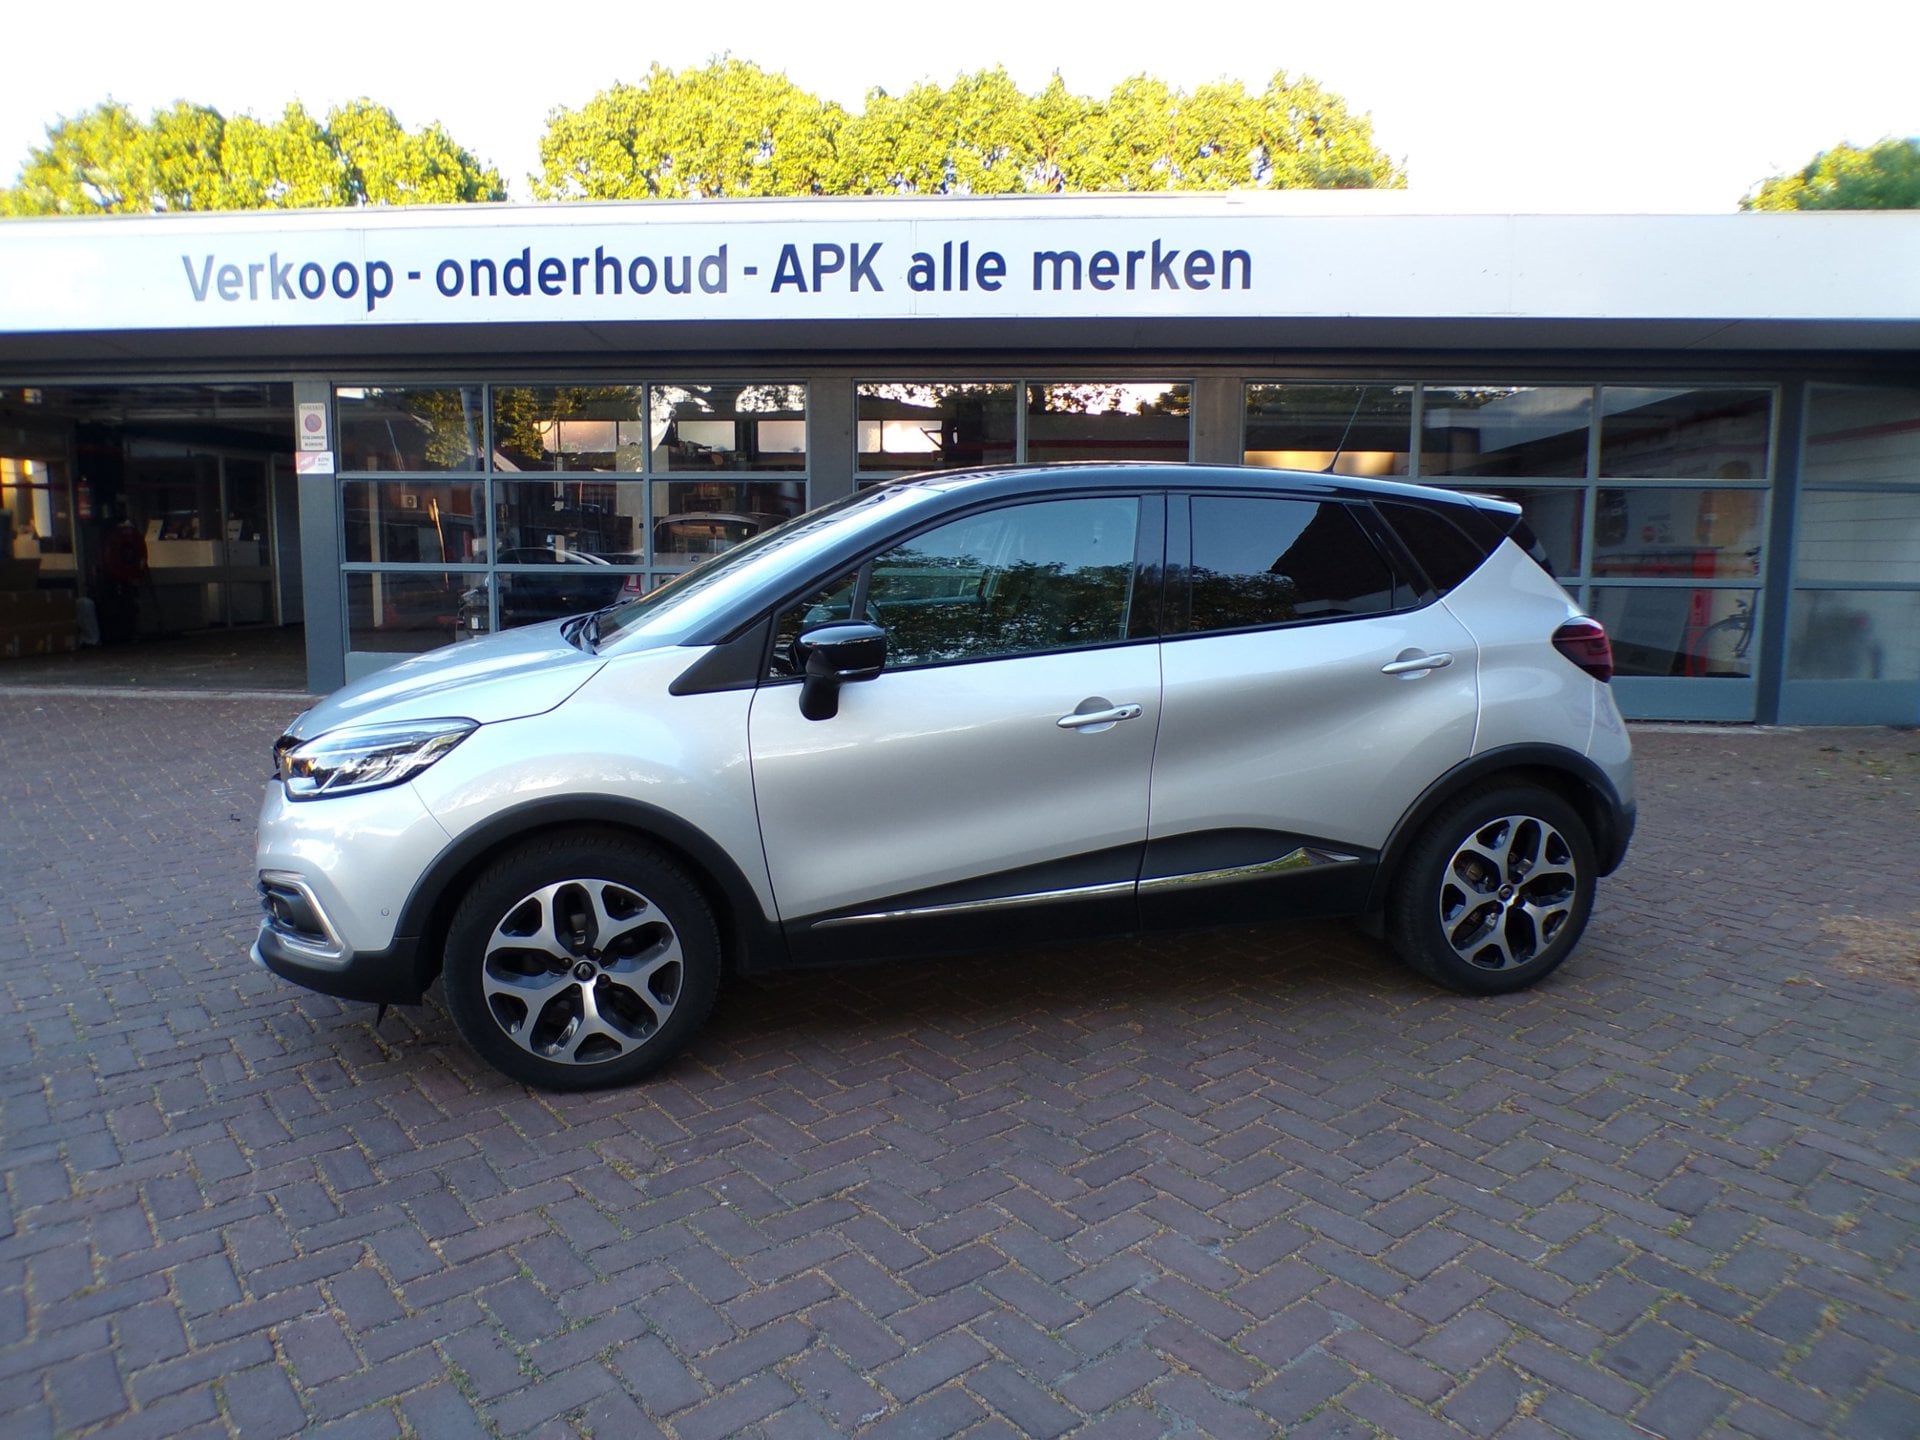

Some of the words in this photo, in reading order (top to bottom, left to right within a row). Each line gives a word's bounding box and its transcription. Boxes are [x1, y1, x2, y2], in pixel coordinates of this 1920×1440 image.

[181, 252, 394, 312] Verkoop
[435, 243, 728, 298] onderhoud
[770, 242, 885, 294] APK
[906, 239, 1007, 293] alle
[1032, 238, 1252, 291] merken
